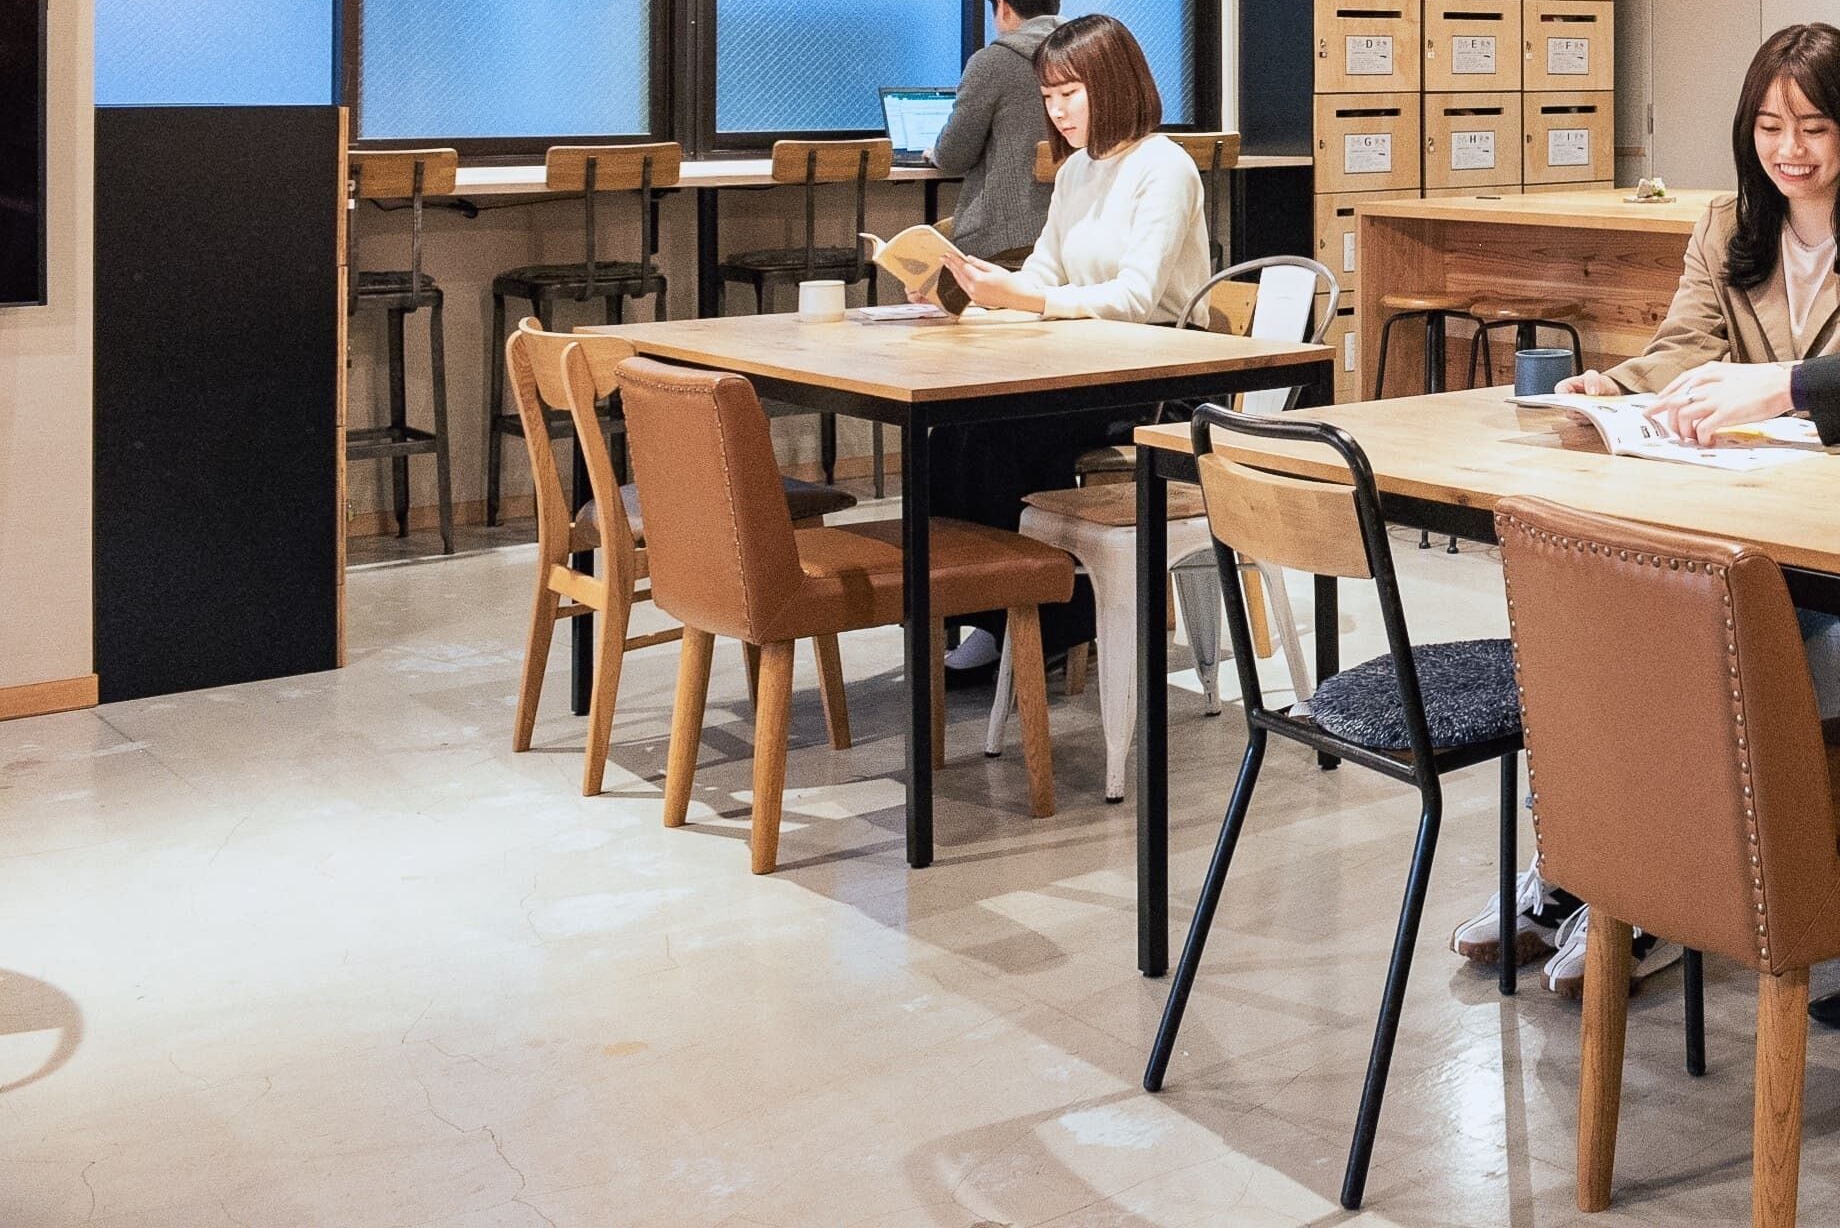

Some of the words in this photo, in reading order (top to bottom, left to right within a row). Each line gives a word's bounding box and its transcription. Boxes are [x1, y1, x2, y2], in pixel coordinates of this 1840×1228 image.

[1366, 40, 1373, 49] D
[1471, 40, 1477, 48] E
[1566, 41, 1571, 50] F
[1364, 137, 1372, 146] G
[1469, 135, 1476, 143] H
